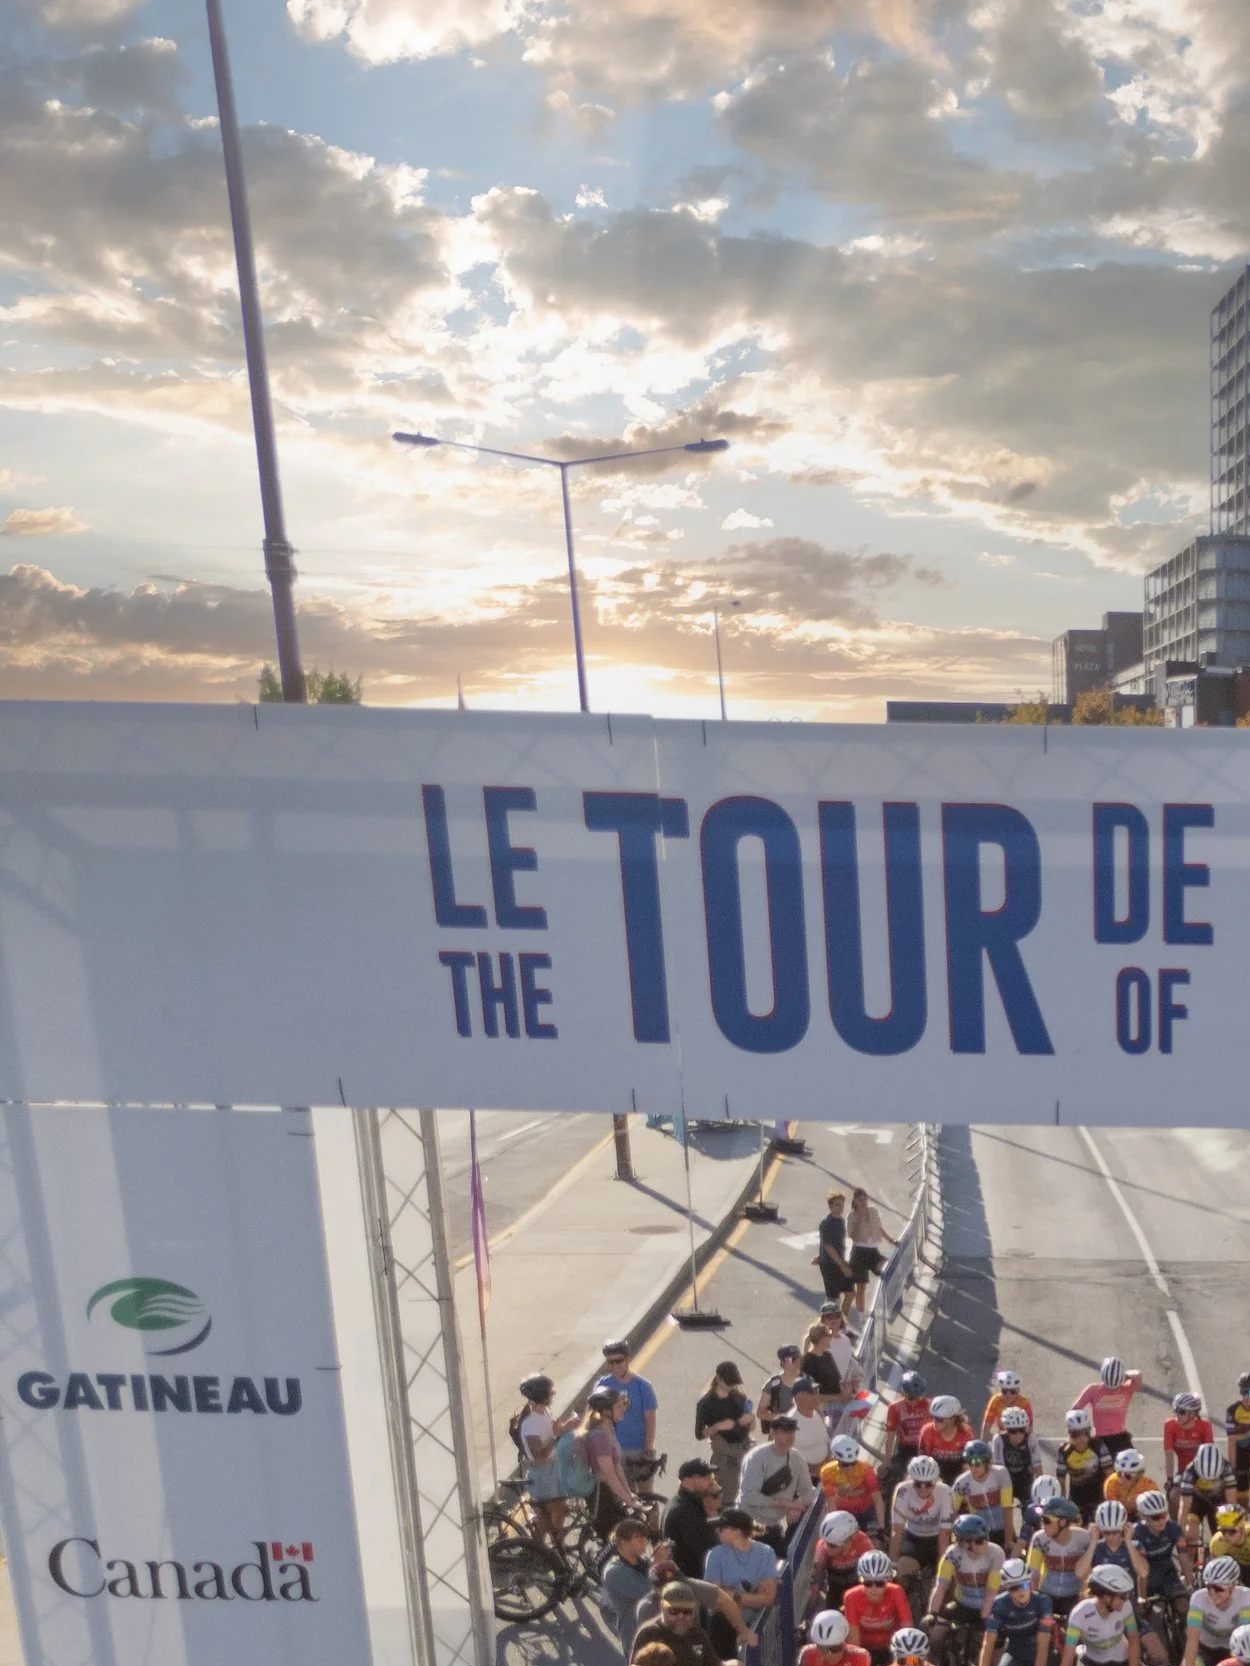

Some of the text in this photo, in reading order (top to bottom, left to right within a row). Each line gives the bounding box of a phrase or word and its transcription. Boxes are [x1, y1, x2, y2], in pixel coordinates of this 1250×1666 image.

[421, 784, 549, 931] LE
[582, 790, 1056, 1057] TOUR
[1093, 801, 1216, 945] DE
[438, 951, 1191, 1056] THE OF
[16, 1370, 302, 1416] GATINEAU
[48, 1536, 321, 1602] Canada
